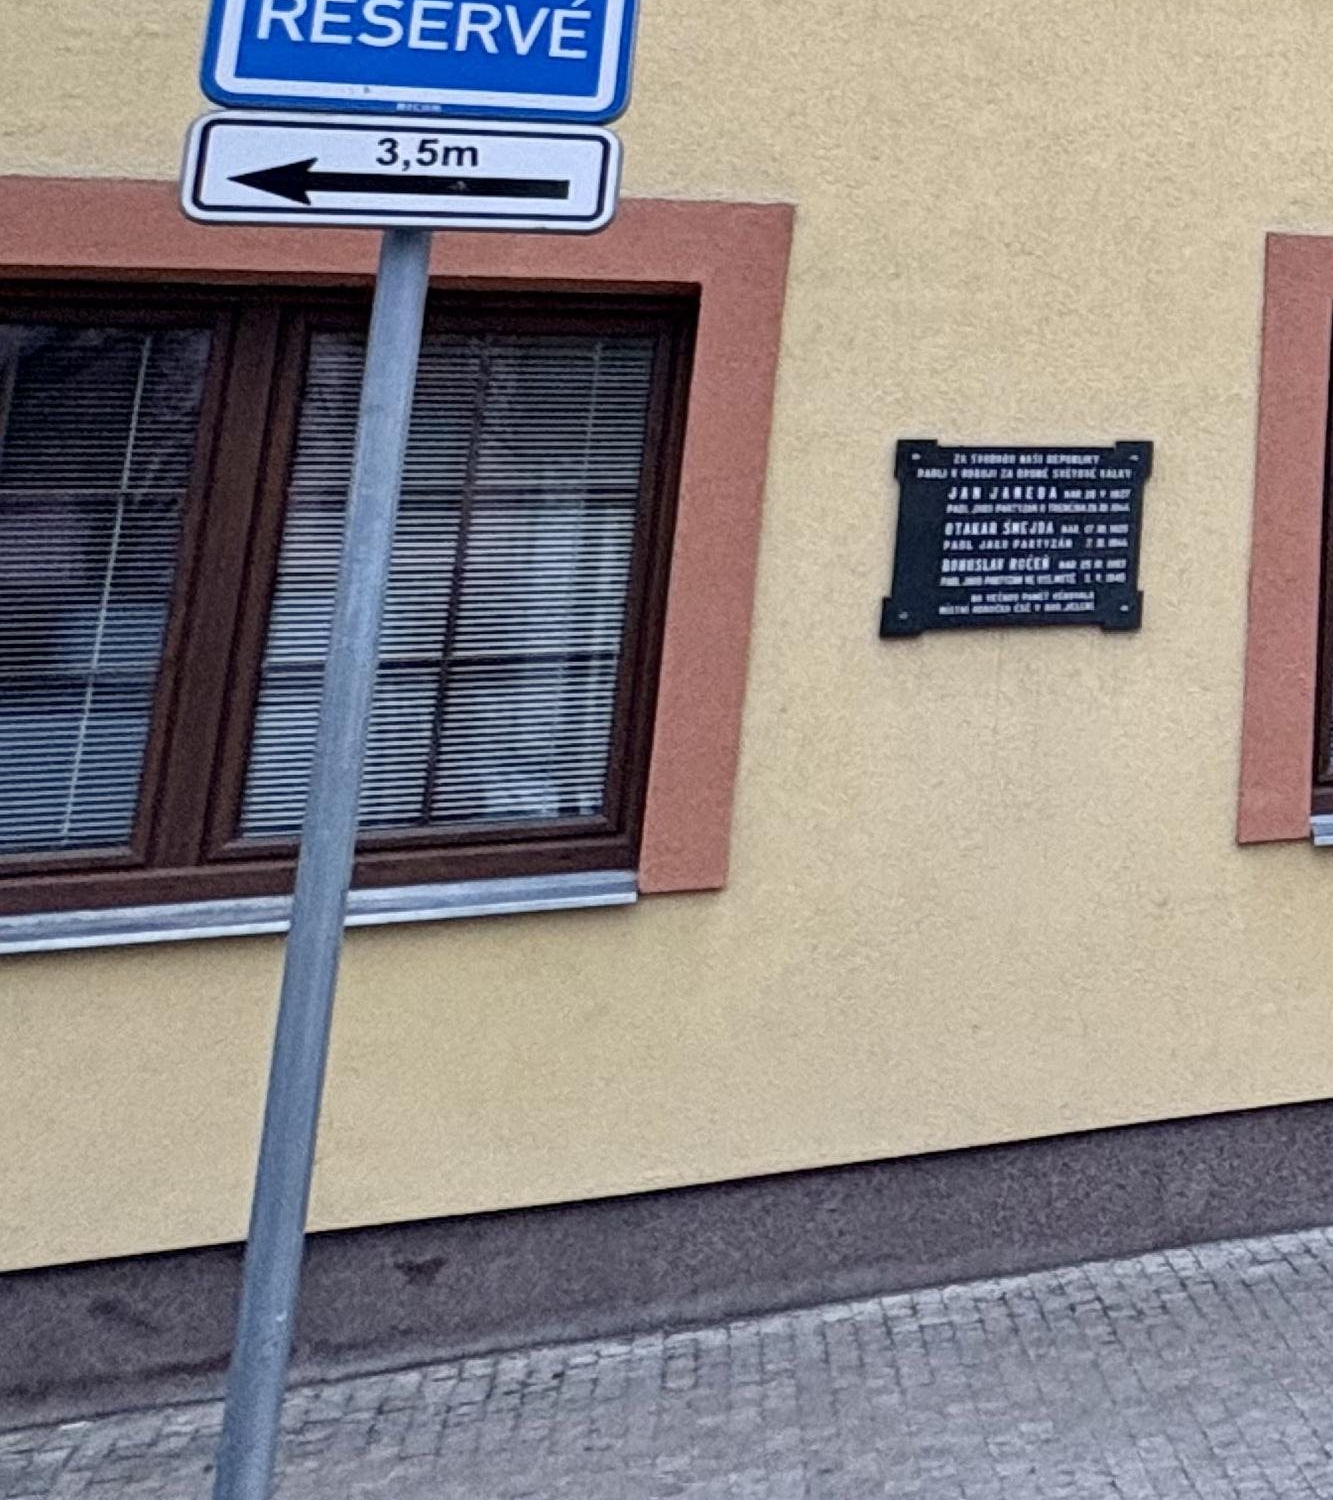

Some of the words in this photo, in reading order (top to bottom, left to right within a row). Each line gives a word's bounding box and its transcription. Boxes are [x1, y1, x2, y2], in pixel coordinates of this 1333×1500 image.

[375, 137, 479, 170] 3,5m
[948, 486, 981, 500] JAN
[944, 521, 998, 536] OTAKAR
